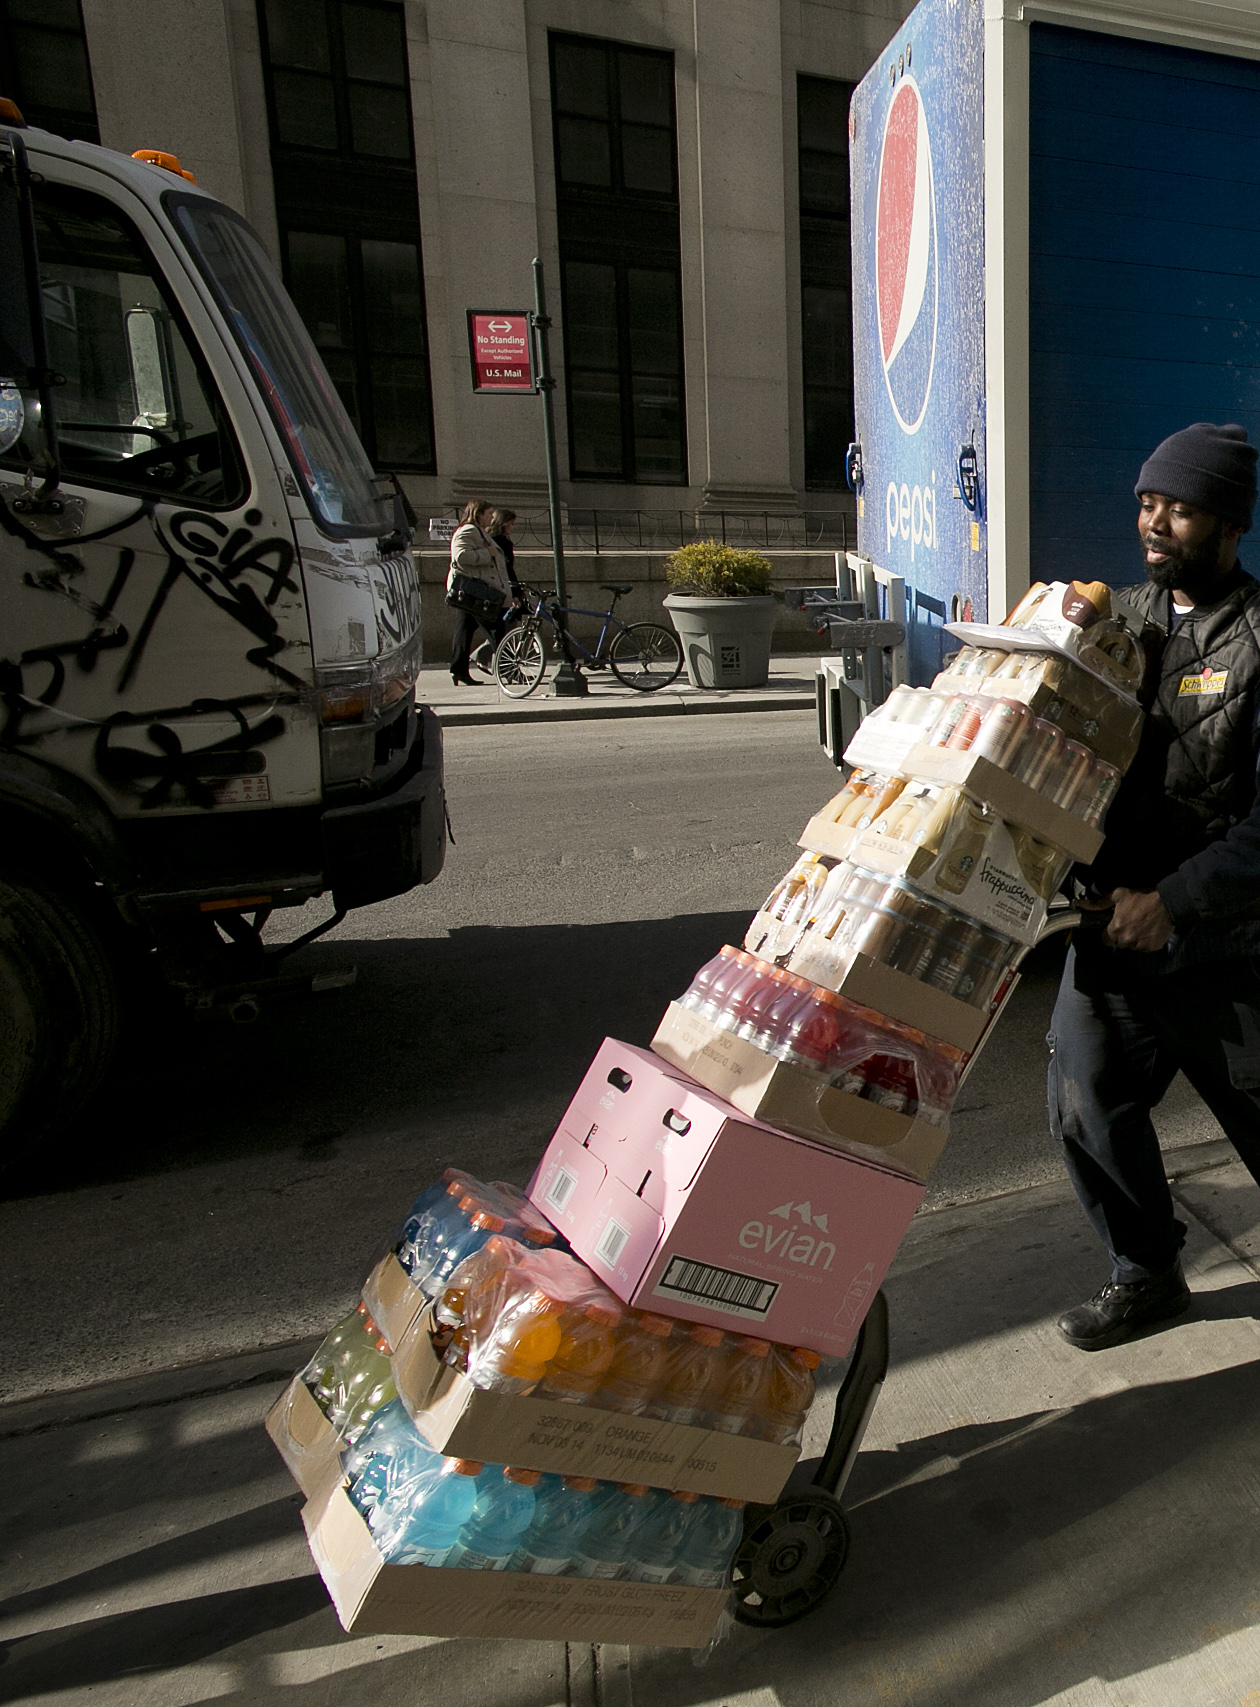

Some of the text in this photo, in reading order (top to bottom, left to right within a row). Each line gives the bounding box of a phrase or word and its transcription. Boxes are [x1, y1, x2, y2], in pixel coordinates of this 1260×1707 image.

[477, 335, 525, 346] No Standing
[486, 369, 522, 377] U.S. Mail
[886, 469, 936, 562] pepsi
[979, 856, 1035, 905] frappuccino
[990, 865, 1018, 882] STARBUCKS
[738, 1220, 836, 1270] evian
[728, 1252, 824, 1285] NATURAL SPRING WATER
[605, 1426, 652, 1444] ORANGE
